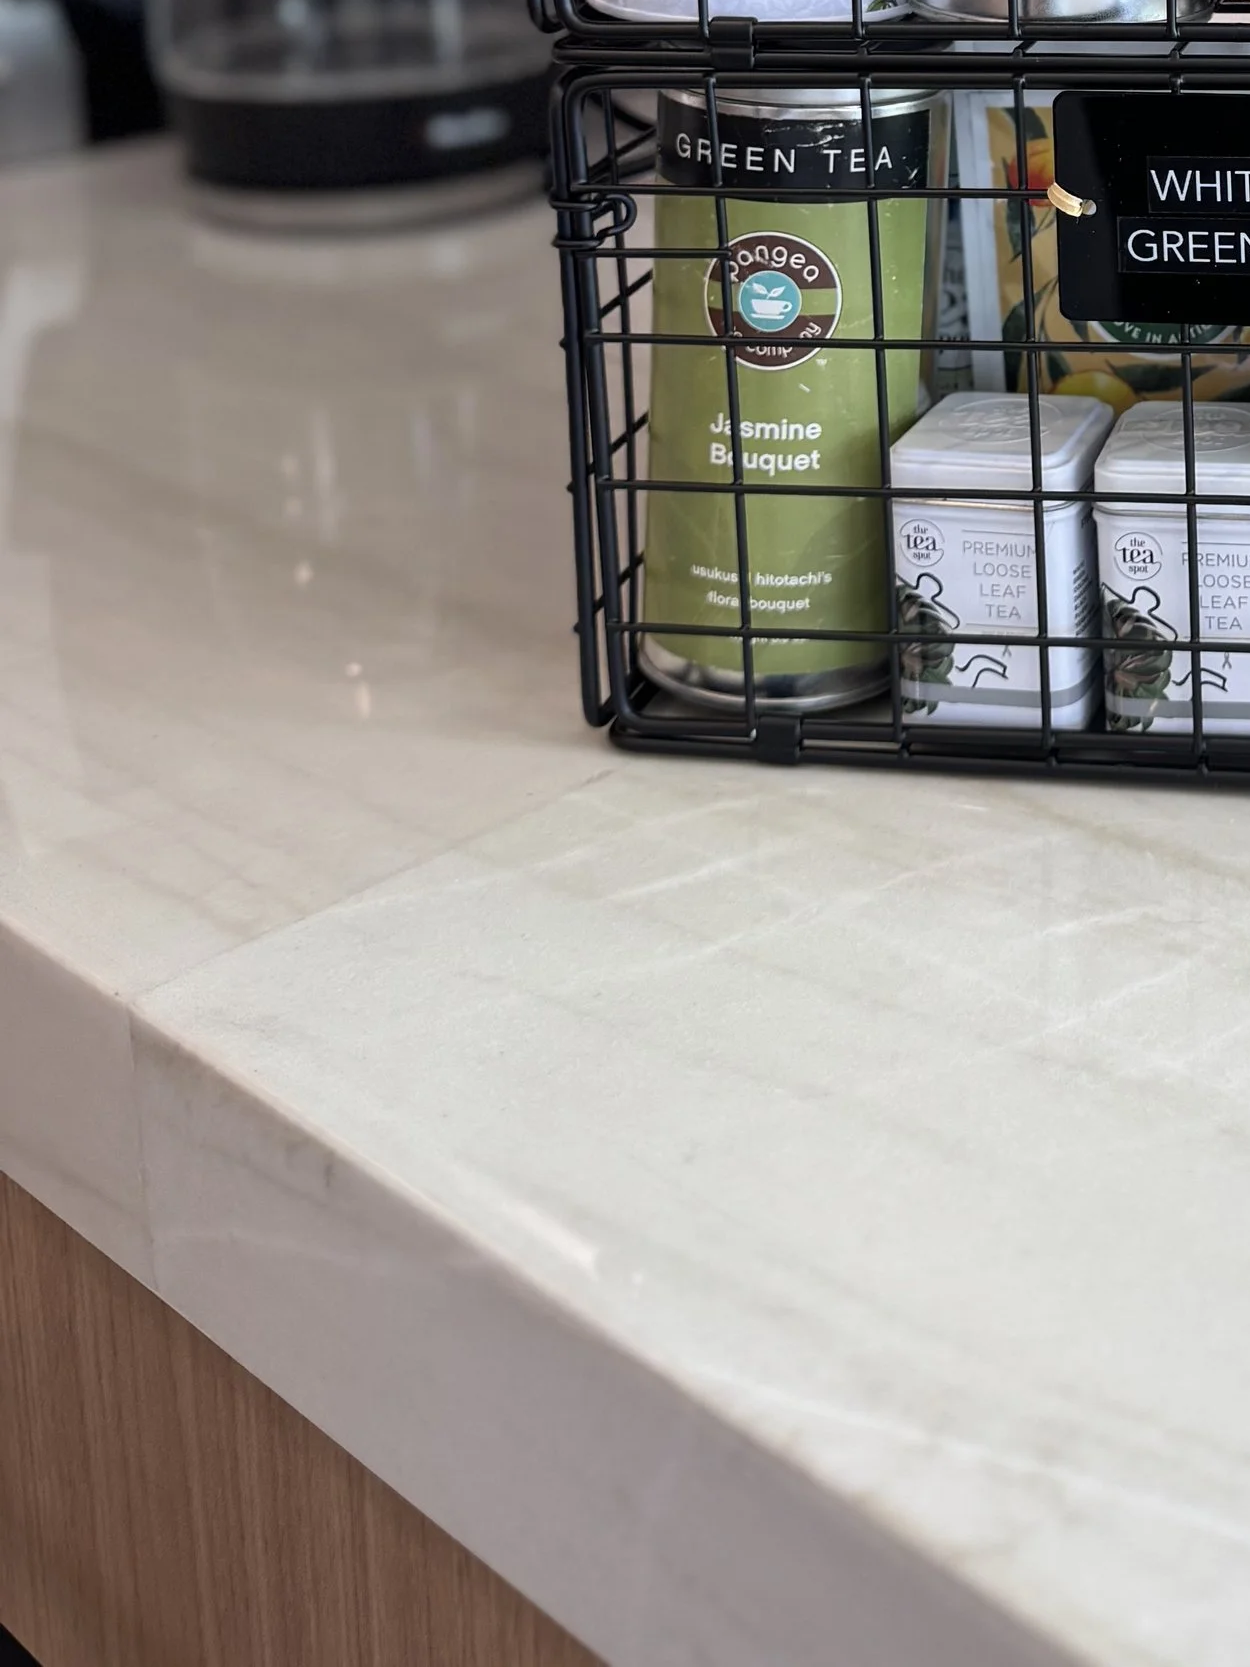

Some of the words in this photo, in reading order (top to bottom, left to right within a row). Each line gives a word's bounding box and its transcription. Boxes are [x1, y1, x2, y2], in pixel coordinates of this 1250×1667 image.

[676, 133, 796, 173] GREEN
[822, 146, 893, 173] TEA
[903, 534, 939, 551] tea
[1130, 537, 1146, 548] the
[1120, 547, 1156, 565] tea
[973, 562, 1032, 579] LOOSE
[1128, 565, 1149, 575] spot
[979, 583, 1026, 599] LEAF
[706, 591, 739, 607] flora
[749, 595, 811, 614] bouquet
[1200, 595, 1248, 610] LEAF
[984, 603, 1022, 620] TEA
[1204, 615, 1243, 631] TEA
